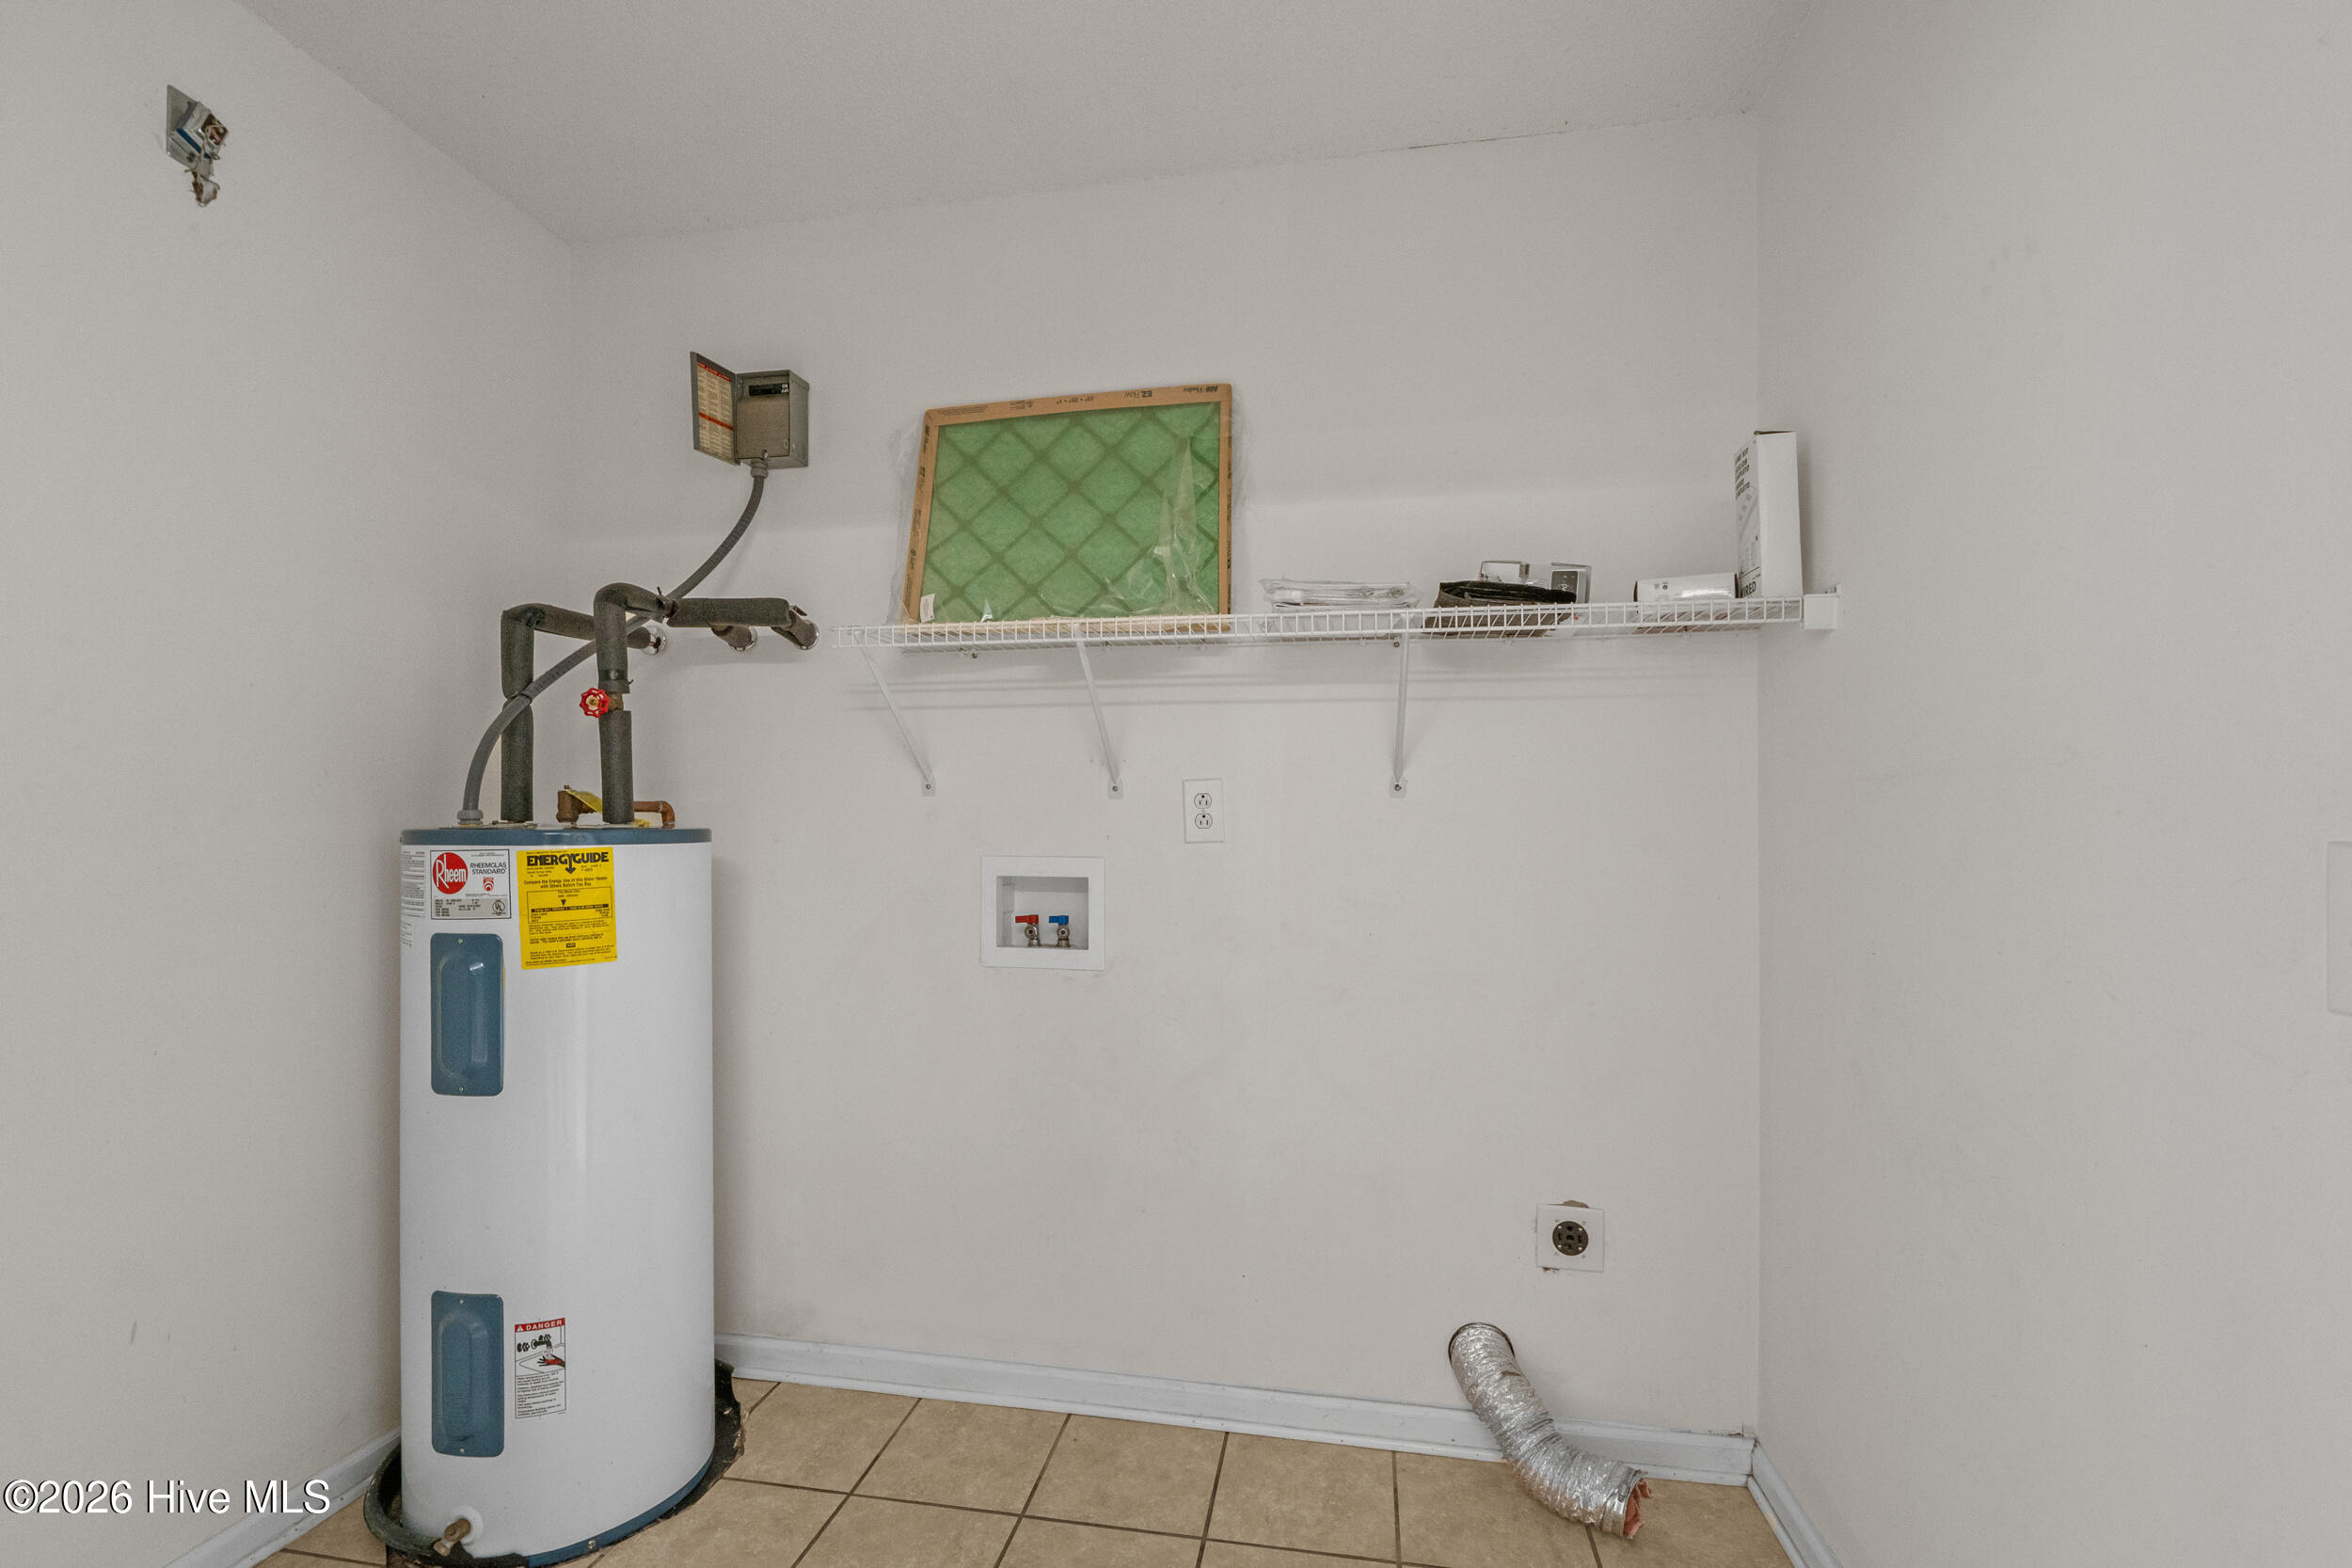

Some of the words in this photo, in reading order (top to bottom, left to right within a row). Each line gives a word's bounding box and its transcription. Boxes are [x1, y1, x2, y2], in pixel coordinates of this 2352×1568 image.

[527, 851, 610, 867] ENERGYGUIDE
[436, 854, 467, 889] Rheem
[526, 1319, 563, 1331] DANGER
